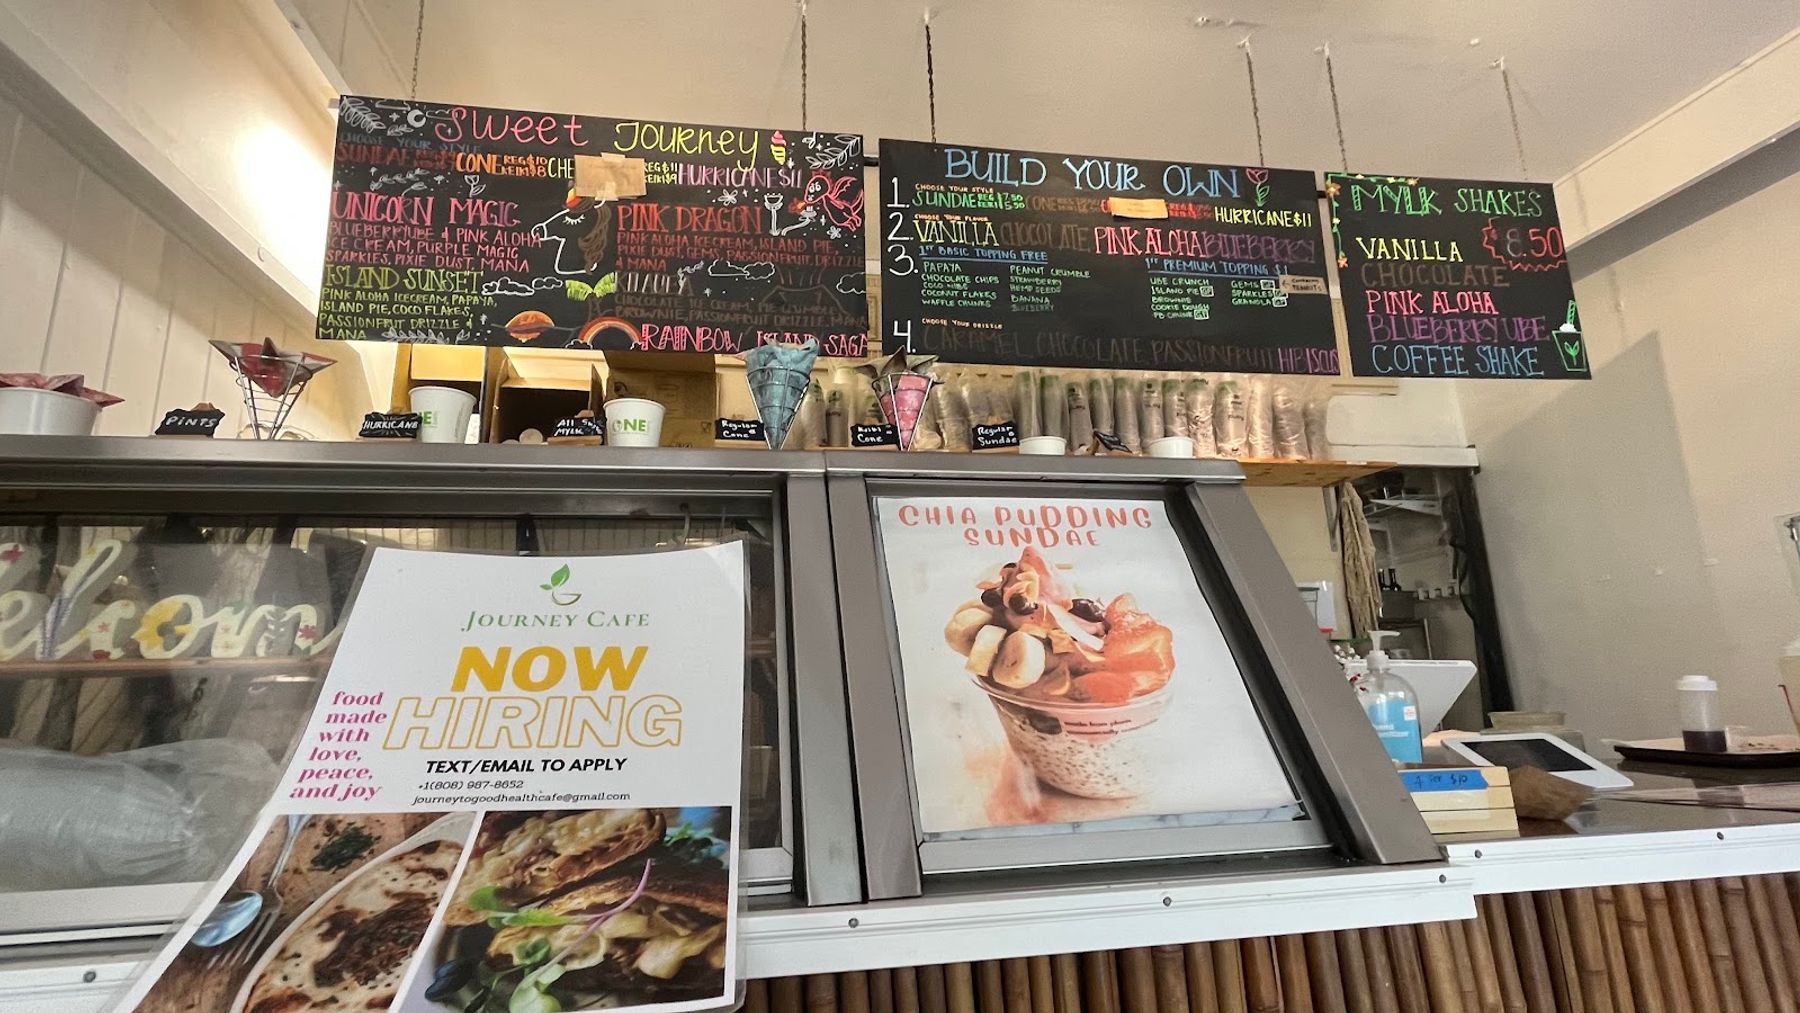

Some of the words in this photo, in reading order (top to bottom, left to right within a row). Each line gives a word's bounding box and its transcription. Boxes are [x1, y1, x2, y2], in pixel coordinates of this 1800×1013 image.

[434, 106, 589, 148] Sweet
[456, 153, 503, 176] CONE
[944, 148, 1047, 187] BUILD
[1062, 158, 1146, 192] YOUR
[1162, 164, 1241, 199] OWN
[886, 176, 910, 208] 1.
[911, 190, 976, 209] SUNDAE
[331, 191, 435, 228] UNICORN
[449, 197, 522, 228] MAGIC
[1351, 184, 1443, 217] MYLK
[1453, 187, 1543, 219] SHAKES
[617, 203, 673, 234] PINK
[675, 205, 763, 236] DRAGON
[886, 211, 914, 241] 2.
[456, 229, 489, 243] PINK
[495, 231, 542, 248] ALOHA
[616, 231, 647, 246] PINK
[651, 233, 689, 247] ALOHA
[759, 237, 808, 252] ISLAND
[912, 219, 1000, 247] VANILLA
[1000, 223, 1092, 253] CHOCOLATE
[1093, 226, 1143, 257] PINK
[1145, 228, 1205, 258] ALOHA
[1203, 231, 1315, 264] BLUEBERRY
[416, 241, 470, 257] PURPLE
[476, 244, 519, 259] MAGIC
[616, 244, 647, 257] PIXIE
[815, 254, 865, 268] DRIZZLE
[938, 246, 970, 258] BASIC
[975, 247, 1018, 260] TOPPING
[1020, 251, 1049, 261] FREE
[1355, 237, 1464, 263] VANILLA
[395, 253, 426, 267] PIXIE
[480, 258, 530, 273] MANA
[627, 258, 667, 272] MANA
[886, 244, 919, 277] 3.
[923, 261, 963, 273] PAPAYA
[1163, 258, 1217, 272] PREMIUM
[1218, 260, 1268, 275] TOPPING
[325, 263, 401, 290] ISLAND
[405, 268, 486, 294] SUNSET
[921, 273, 971, 284] CHOCOLATE
[974, 275, 1000, 285] CHIPS
[1009, 265, 1045, 275] PEANUT
[1050, 268, 1090, 279] CRUMBLE
[1009, 275, 1062, 286] STRAWBERRY
[1360, 263, 1511, 289] CHOCOLATE
[1150, 277, 1169, 286] UBE
[1171, 277, 1210, 286] CRUNCH
[1151, 285, 1184, 296] ISLAND
[1230, 279, 1259, 289] GEMS
[321, 287, 353, 301] PINK
[355, 290, 390, 303] ALOHA
[614, 293, 684, 309] CHOCOLATE
[921, 289, 960, 299] COCONUT
[962, 290, 998, 301] FLAKES
[921, 298, 956, 308] WAFFLE
[1010, 294, 1050, 305] BANANA
[1231, 289, 1274, 299] SPARKLES
[1231, 298, 1272, 307] GRANOLA
[320, 299, 364, 314] ISLAND
[392, 303, 422, 317] COCO
[1151, 303, 1180, 312] COOKIE
[1365, 290, 1425, 316] PINK
[1431, 291, 1500, 317] ALOHA
[410, 316, 460, 331] DRIZZLE
[1366, 313, 1501, 345] BLUEBERRY
[1504, 316, 1551, 344] UBE
[318, 327, 367, 341] MANA
[640, 322, 743, 353] RAINBOW
[892, 319, 917, 353] 4.
[923, 326, 1034, 359] CARAMEL
[1036, 332, 1141, 366] CHOCOLATE
[1371, 345, 1469, 376] COFFEE
[1474, 346, 1545, 378] SHAKE
[362, 420, 419, 430] HURRICANE
[976, 426, 1014, 438] Regular
[857, 433, 885, 443] Cone
[976, 436, 1018, 447] Sundae
[898, 504, 977, 527] CHIA
[994, 504, 1152, 529] PUDDING
[964, 527, 1102, 549] SUNDAE
[450, 645, 649, 692] NOW
[332, 690, 384, 706] food
[324, 708, 388, 724] made
[382, 694, 683, 750] HIRING
[318, 726, 370, 742] with
[307, 745, 363, 763] love,
[426, 758, 536, 775] TEXT/EMAIL
[541, 758, 568, 773] TO
[569, 757, 629, 773] APPLY
[297, 766, 375, 787] peace,
[467, 780, 525, 790] 987-8652
[289, 783, 336, 799] and
[337, 784, 383, 803] joy
[412, 791, 631, 806] journeytogoodhealthcafe@gmail.com
